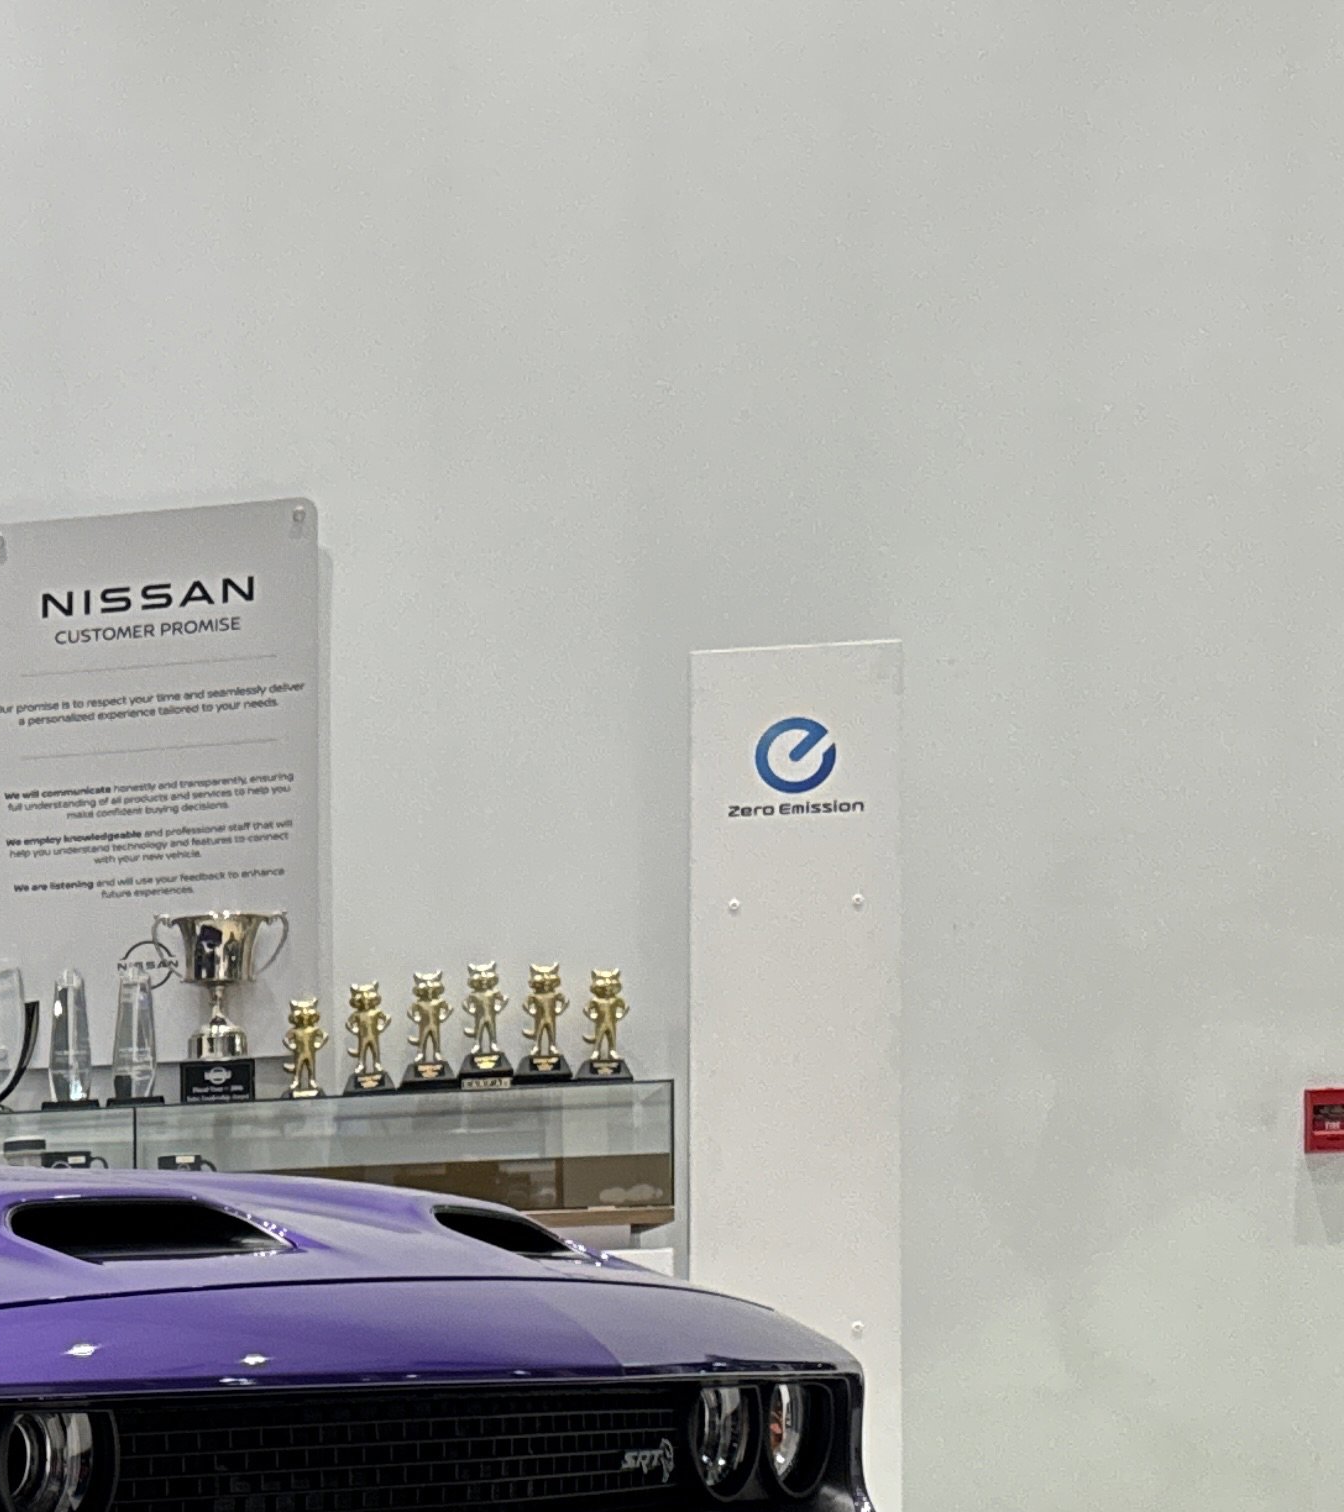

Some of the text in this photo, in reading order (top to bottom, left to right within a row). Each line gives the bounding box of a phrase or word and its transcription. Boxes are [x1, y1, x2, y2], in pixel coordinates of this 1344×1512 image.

[42, 576, 254, 618] NISSAN
[55, 616, 241, 645] CUSTOMER PROMISE
[16, 701, 59, 714] promise
[62, 700, 70, 709] is
[73, 699, 84, 709] to
[87, 696, 126, 708] respect
[129, 695, 153, 706] your
[156, 693, 181, 702] time
[184, 690, 204, 700] and
[207, 684, 267, 699] seamlessly
[269, 682, 305, 693] deliver
[19, 718, 25, 726] a
[28, 712, 95, 726] personalized
[97, 709, 155, 721] experience
[158, 704, 199, 715] tailored
[202, 702, 213, 712] to
[215, 701, 241, 713] your
[22, 790, 40, 799] will
[41, 786, 111, 798] communicate
[113, 782, 156, 793] honestly
[158, 780, 177, 790] and
[249, 772, 294, 783] ensuring
[24, 799, 97, 811] understanding
[124, 793, 168, 805] products
[170, 791, 190, 801] and
[192, 788, 233, 798] services
[234, 787, 245, 796] to
[247, 785, 269, 796] help
[96, 807, 143, 818] confident
[145, 804, 179, 815] buying
[727, 800, 865, 818] Zero Emission
[9, 831, 289, 859] help you understand technology and features to connect
[23, 836, 62, 847] employ
[63, 830, 142, 842] knowledgeable
[144, 829, 163, 838] and
[165, 825, 226, 838] professional
[228, 822, 250, 832] staff
[253, 820, 274, 830] that
[276, 819, 293, 829] will
[93, 855, 116, 865] with
[117, 854, 140, 865] your
[142, 853, 163, 862] new
[14, 868, 285, 892] We are listening and will use your feedback to enhance
[101, 889, 132, 899] future
[117, 959, 179, 972] NSSAN
[621, 1449, 664, 1475] SRT
